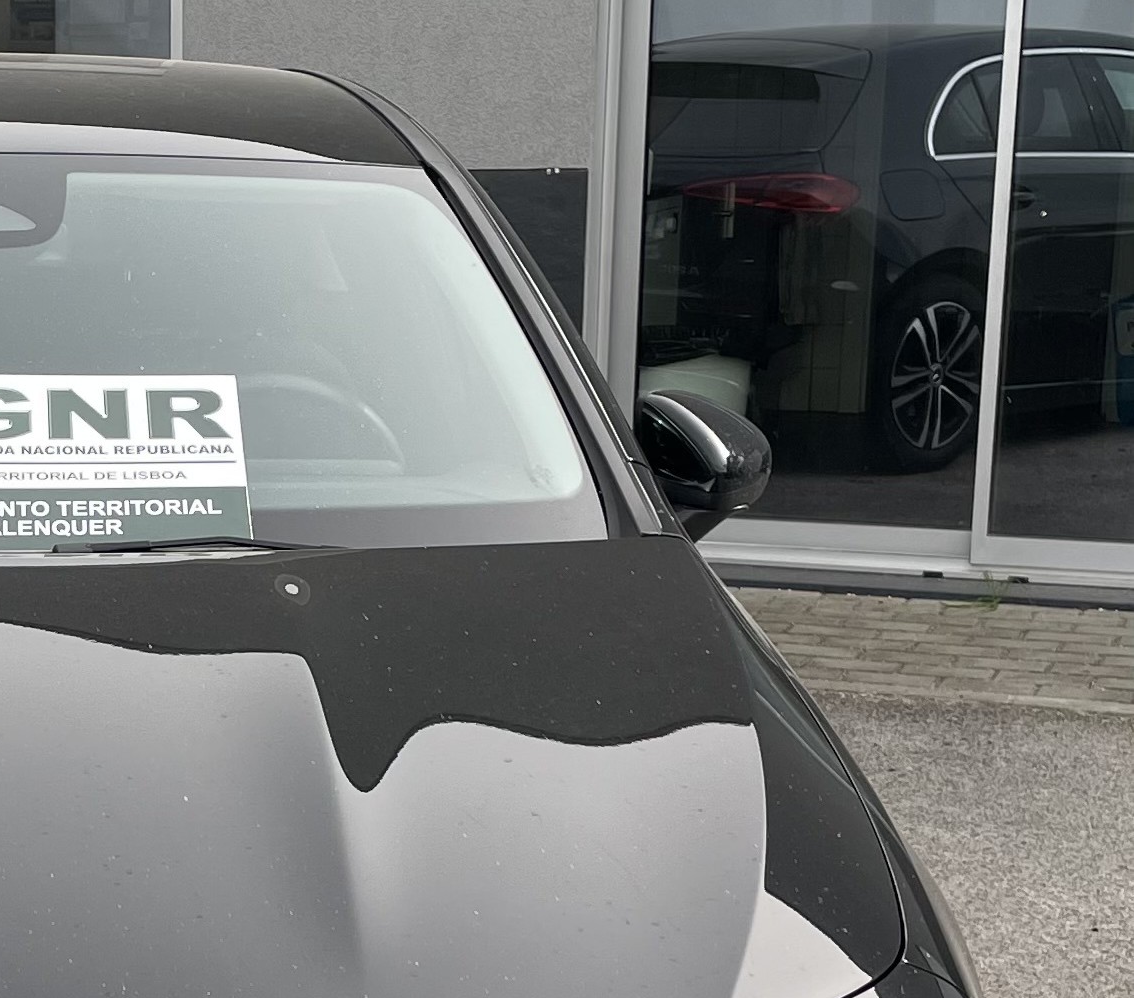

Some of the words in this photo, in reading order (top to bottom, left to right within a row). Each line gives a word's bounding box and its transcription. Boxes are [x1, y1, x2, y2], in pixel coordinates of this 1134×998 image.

[21, 445, 108, 455] NACIONAL
[114, 444, 234, 455] REPUBLICANA
[94, 470, 117, 481] DE
[123, 470, 187, 481] LISBOA
[56, 499, 223, 516] TERRITORIAL
